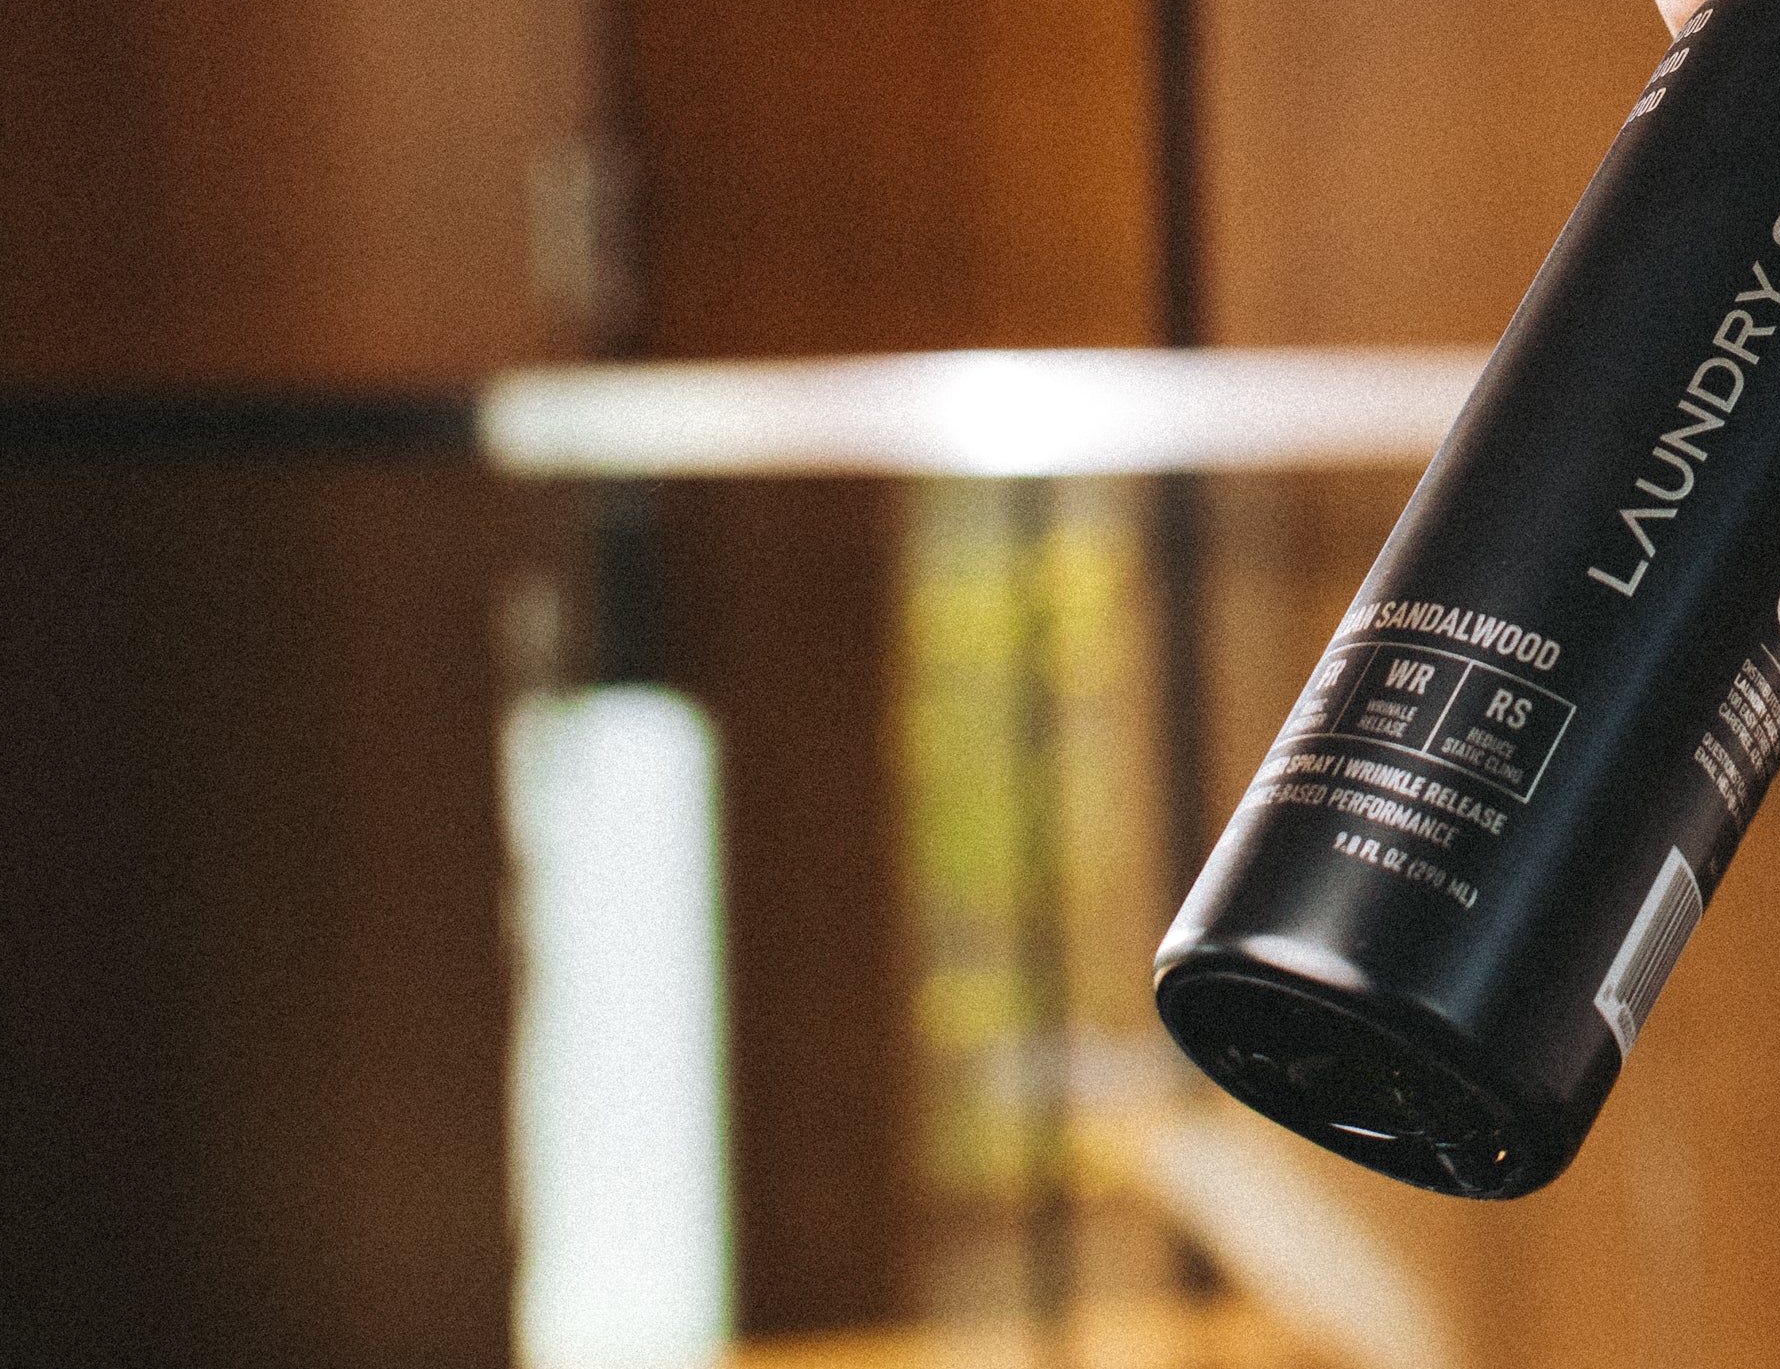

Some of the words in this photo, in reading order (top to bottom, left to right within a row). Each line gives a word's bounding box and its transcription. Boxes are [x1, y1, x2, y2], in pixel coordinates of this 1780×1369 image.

[1375, 600, 1561, 671] SANDALWOOD
[1384, 658, 1436, 695] WR
[1357, 714, 1408, 738] RELEASE
[1485, 687, 1533, 729] RS
[1440, 736, 1484, 767] STATIC
[1284, 753, 1335, 776] SPRAY
[1344, 757, 1427, 799] WRINKLE
[1422, 781, 1509, 836] RELEASE
[1326, 788, 1461, 849] PERFORMANCE
[1332, 830, 1362, 857] 9.8
[1358, 838, 1381, 865] FL
[1383, 847, 1409, 873] OZ
[1447, 881, 1479, 911] ML)
